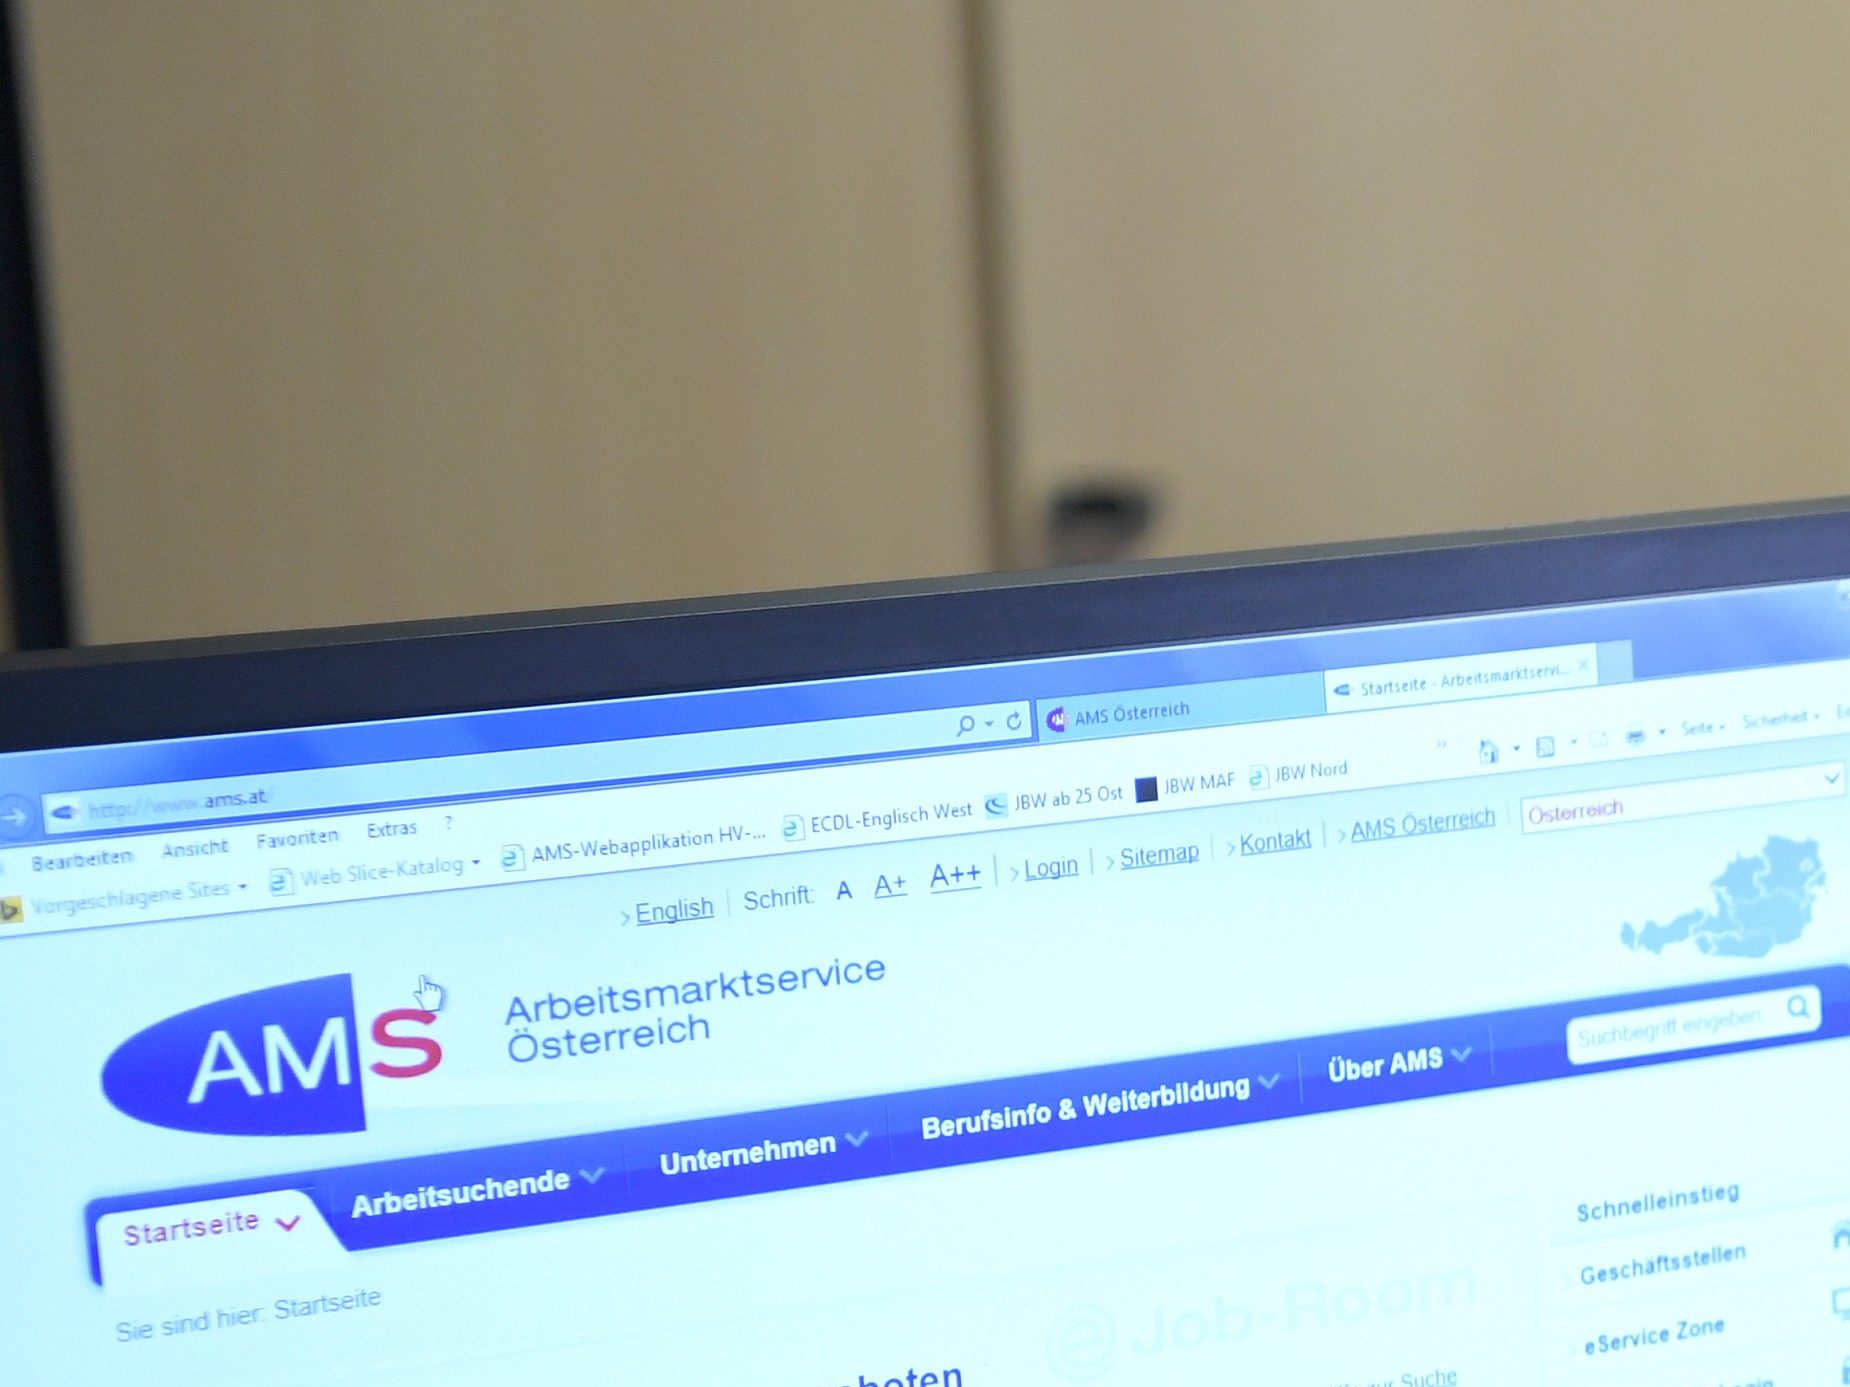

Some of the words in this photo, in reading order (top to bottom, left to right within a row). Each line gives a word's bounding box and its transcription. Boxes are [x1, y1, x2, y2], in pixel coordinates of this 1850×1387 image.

[1361, 677, 1427, 697] Startseite
[1075, 709, 1109, 727] AMS
[1114, 701, 1190, 723] Österreich
[1682, 721, 1713, 737] Seite
[30, 882, 182, 916] Vorgeschlagene
[187, 880, 230, 900] Sites
[300, 867, 342, 888] Web
[348, 856, 465, 884] Slice-Katalog
[532, 829, 714, 863] AMS-Webapplikation
[811, 805, 929, 834] ECDL-Englisch
[934, 802, 973, 820] West
[1014, 792, 1048, 812] JBW
[1052, 789, 1071, 807] ab
[1075, 787, 1093, 804] 25
[1097, 785, 1123, 802] Ost
[1164, 777, 1197, 796] JBW
[1200, 772, 1235, 791] MAF
[1275, 765, 1307, 784] JBW
[1311, 761, 1348, 779] Nord
[32, 847, 135, 873] Bearbeiten
[162, 837, 229, 860] Ansicht
[257, 826, 341, 850] Favoriten
[367, 819, 418, 840] Extras
[636, 896, 714, 925] English
[744, 885, 815, 912] Schrift:
[837, 881, 853, 899] A
[875, 874, 906, 897] A+
[931, 861, 981, 888] A++
[1025, 855, 1079, 881] Login
[1120, 843, 1200, 868] Sitemap
[1240, 828, 1312, 855] Kontakt
[1351, 818, 1396, 843] AMS
[1402, 805, 1496, 834] Österreich
[504, 957, 887, 1027] Arbeitsmarktservice
[187, 1008, 442, 1105] AMS
[507, 1012, 711, 1065] Österreich
[124, 1210, 261, 1248] Startseite
[351, 1169, 571, 1220] Arbeitsuchende
[659, 1132, 837, 1176] Unternehmen
[921, 1100, 1053, 1141] Berufsinfo
[1058, 1097, 1077, 1121] &
[1083, 1074, 1251, 1119] Weiterbildung
[1328, 1054, 1385, 1084] Über
[1390, 1046, 1444, 1075] AMS
[1578, 1017, 1679, 1050] Suchbegriff
[1683, 1006, 1763, 1036] eingeben
[1577, 1183, 1740, 1223] Schnelleinstieg
[1580, 1244, 1747, 1285] Geschäftsstellen
[115, 1321, 154, 1343] Sie
[162, 1310, 209, 1338] sind
[274, 1286, 382, 1320] Startseite
[1585, 1327, 1670, 1355] eService
[1677, 1317, 1725, 1341] Zone
